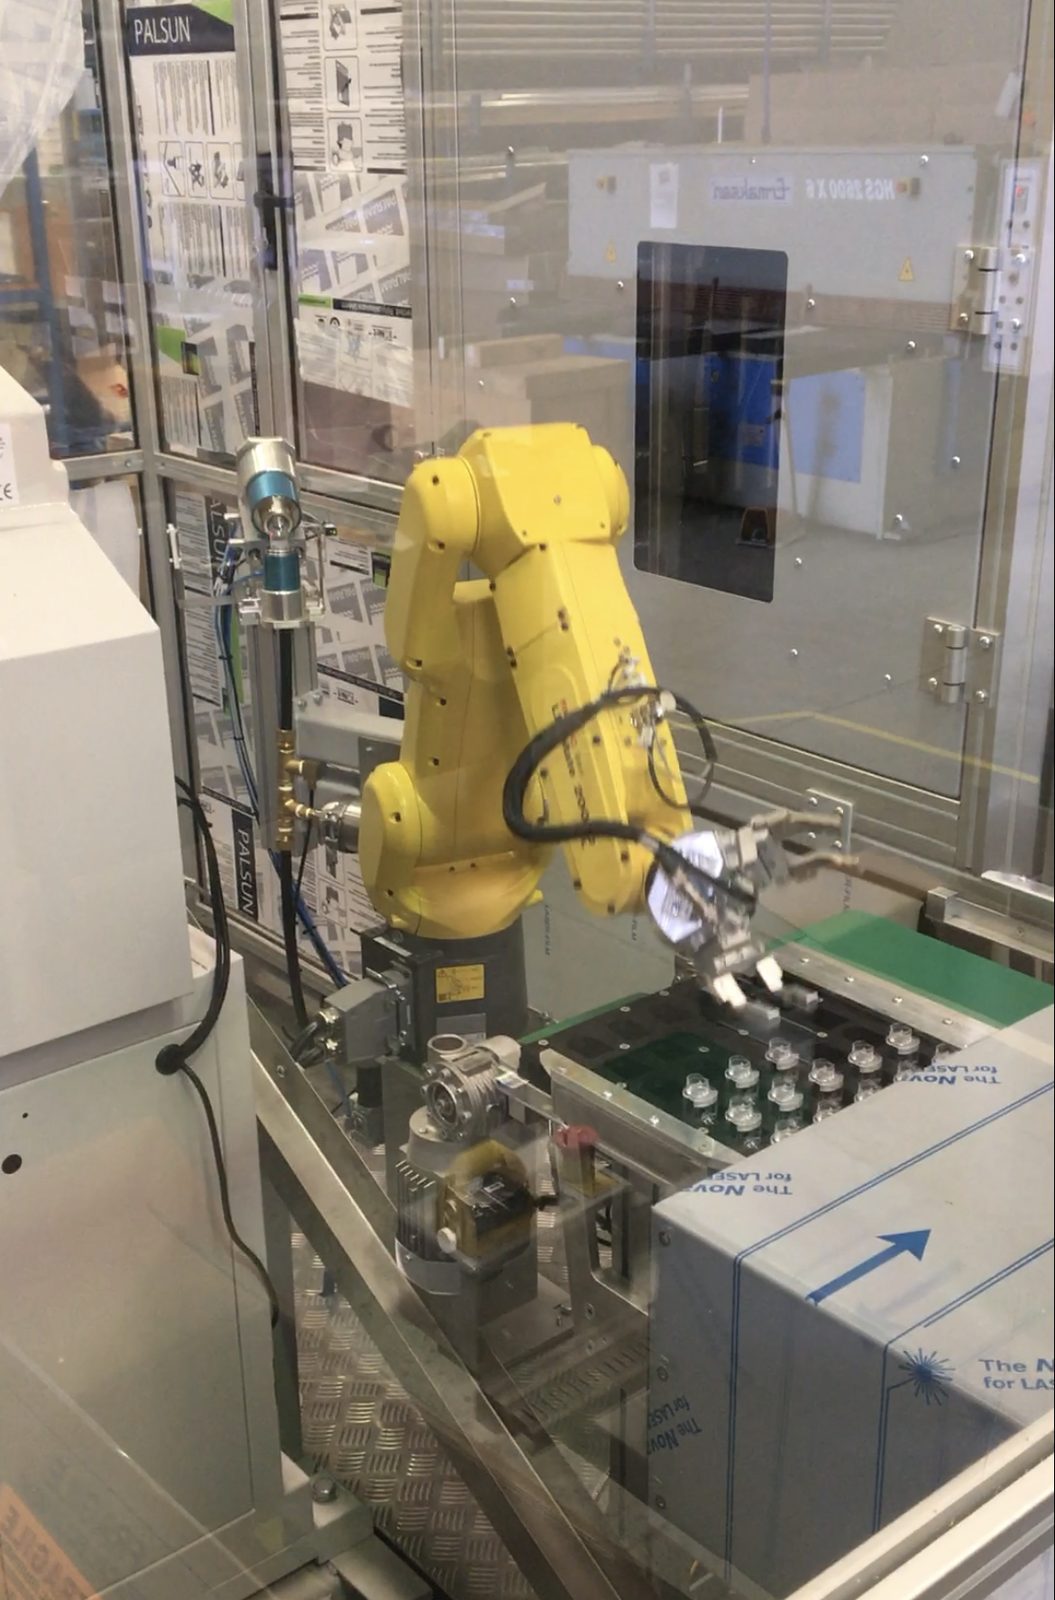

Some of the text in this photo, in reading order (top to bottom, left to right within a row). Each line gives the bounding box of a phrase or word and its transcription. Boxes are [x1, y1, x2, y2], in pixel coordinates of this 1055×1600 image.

[133, 15, 192, 45] PALSUN
[209, 497, 226, 567] ALSU
[237, 828, 254, 916] PALSUN
[972, 1065, 999, 1075] for
[963, 1074, 1001, 1085] The
[708, 1171, 792, 1183] for LASE
[752, 1184, 793, 1196] The
[978, 1359, 1027, 1373] The
[983, 1375, 1016, 1389] for
[672, 1395, 691, 1412] for
[678, 1418, 703, 1436] The
